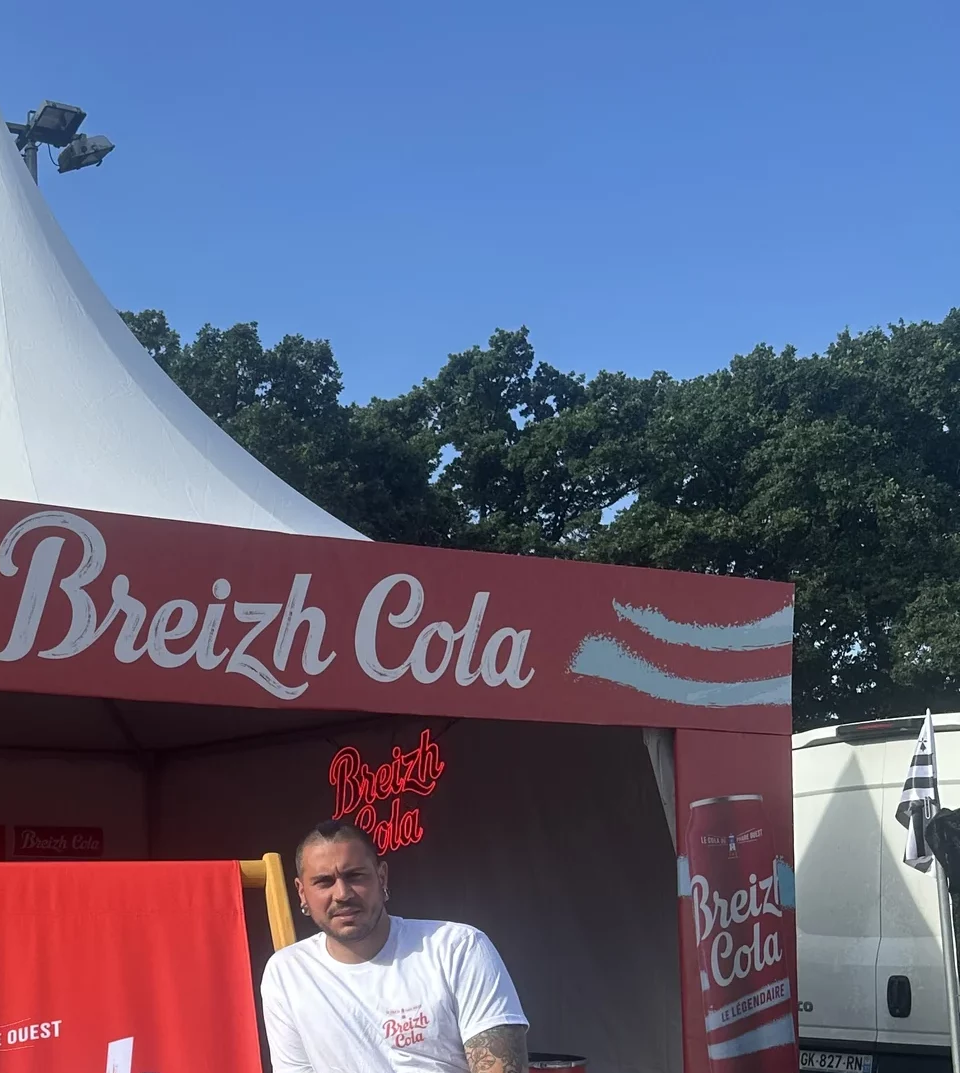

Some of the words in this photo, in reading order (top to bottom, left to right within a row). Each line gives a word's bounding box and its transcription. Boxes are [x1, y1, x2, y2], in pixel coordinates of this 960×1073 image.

[355, 573, 535, 689] Cola
[329, 729, 445, 820] Breizh
[354, 798, 424, 856] Cola
[711, 922, 783, 987] Cola
[382, 1012, 430, 1039] Breizh
[721, 1011, 730, 1023] LE
[731, 983, 785, 1018] LÉGENDAIRE
[7, 1020, 62, 1045] OUEST
[395, 1030, 425, 1048] Cola
